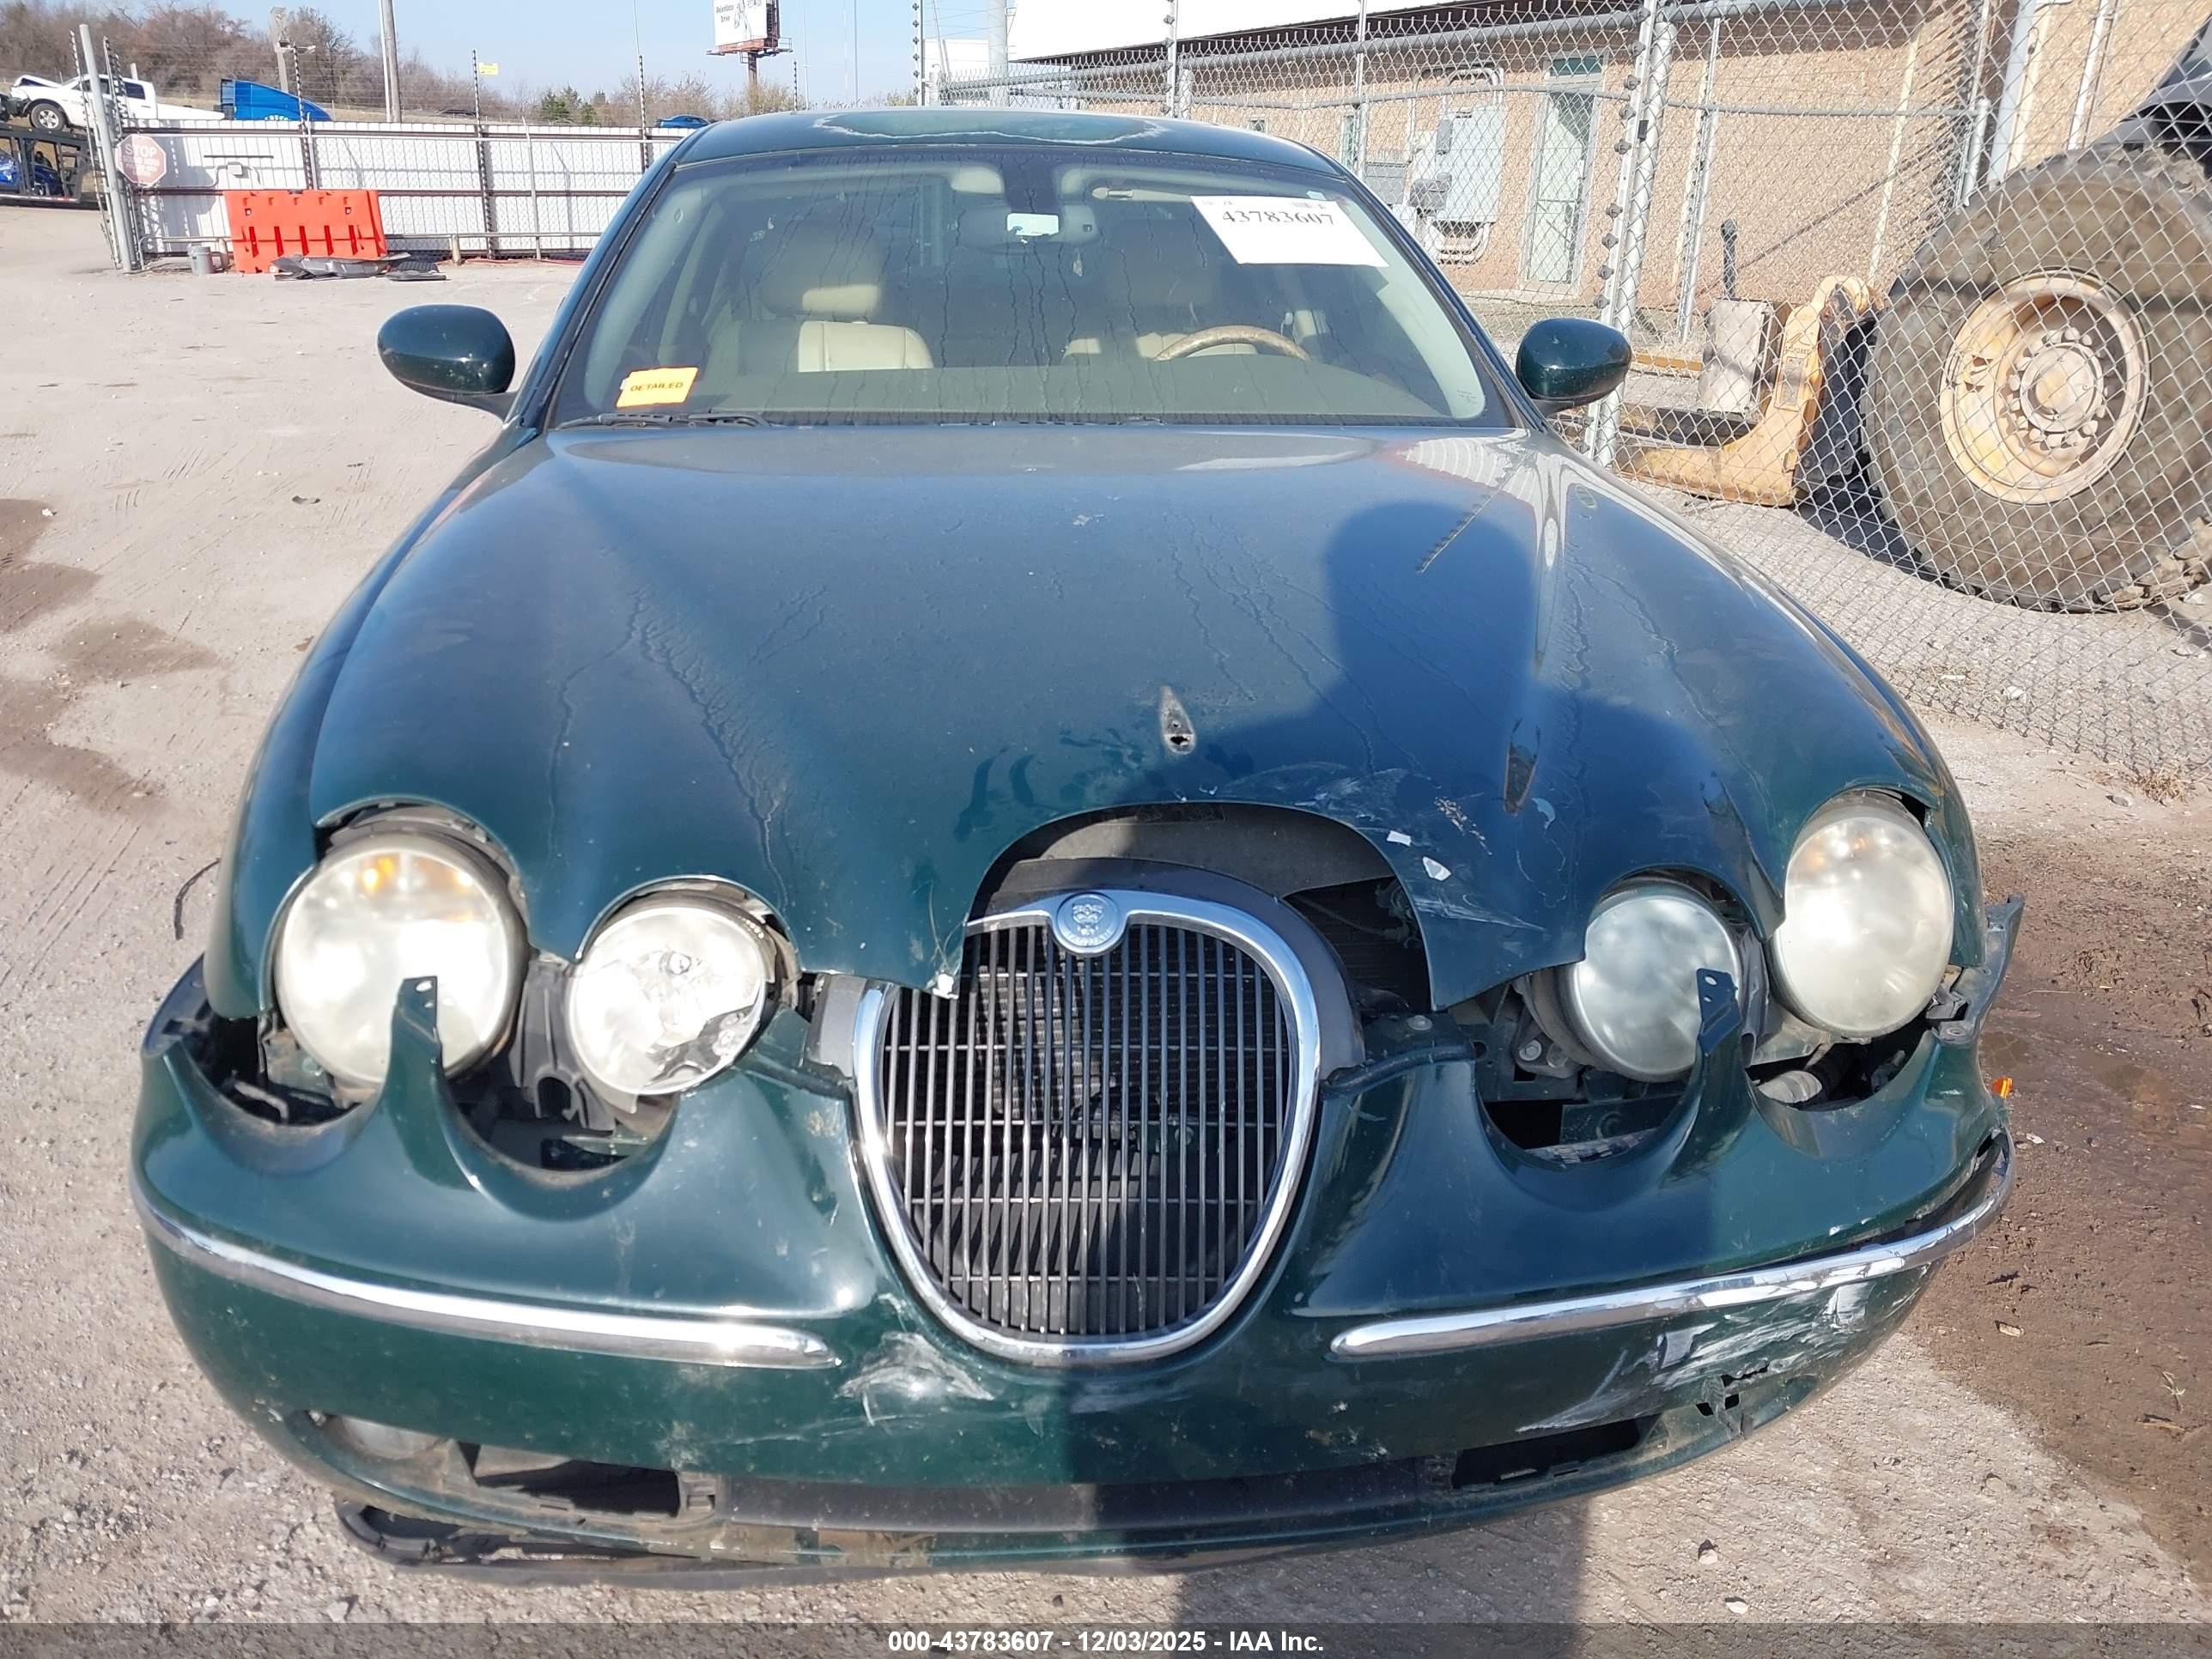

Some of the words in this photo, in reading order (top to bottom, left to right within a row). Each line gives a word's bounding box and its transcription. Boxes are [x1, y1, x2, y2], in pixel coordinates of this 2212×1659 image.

[125, 143, 157, 158] STOP
[1223, 210, 1334, 225] 43783607
[630, 381, 684, 392] DETAILED
